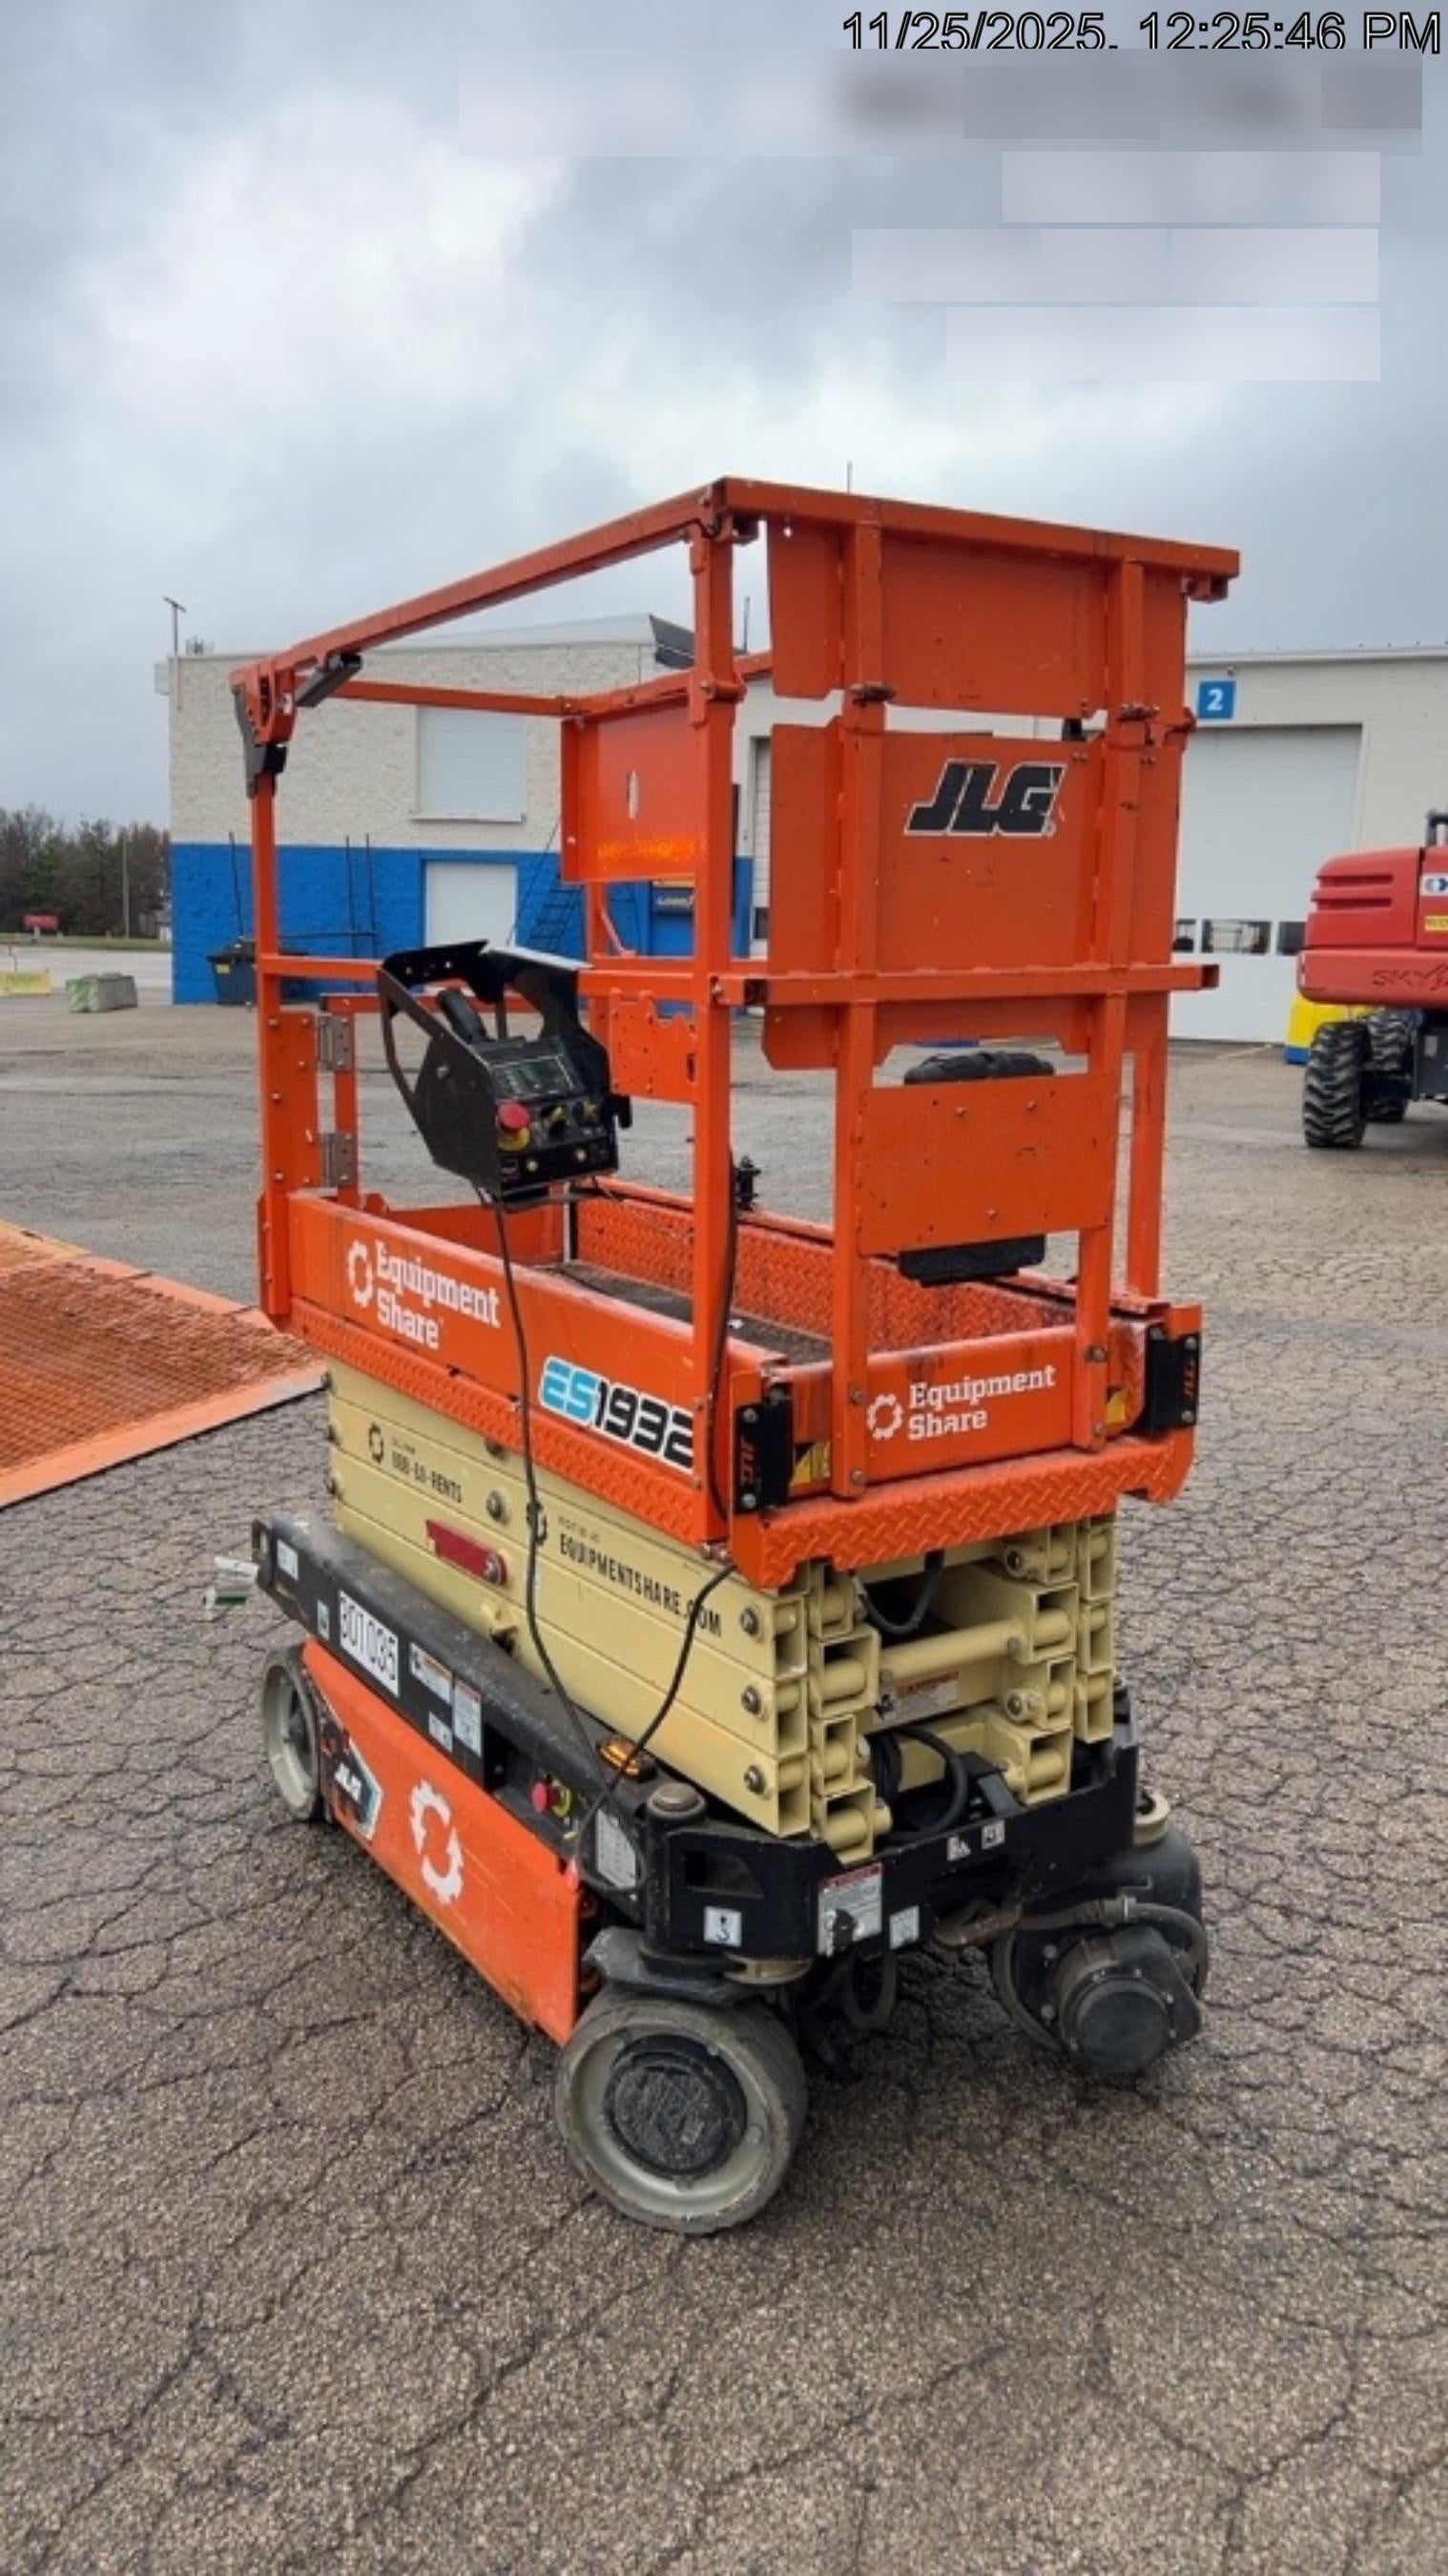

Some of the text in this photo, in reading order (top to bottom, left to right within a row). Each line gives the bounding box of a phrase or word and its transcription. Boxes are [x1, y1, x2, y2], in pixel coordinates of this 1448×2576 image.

[1207, 688, 1223, 711] 2
[904, 758, 1066, 837] JLG
[1373, 964, 1448, 991] SKYJ
[375, 1239, 500, 1328] Equipment
[377, 1288, 439, 1349] Share
[909, 1365, 1056, 1411] Equipment
[539, 1356, 693, 1474] ES1932
[909, 1410, 988, 1441] Share
